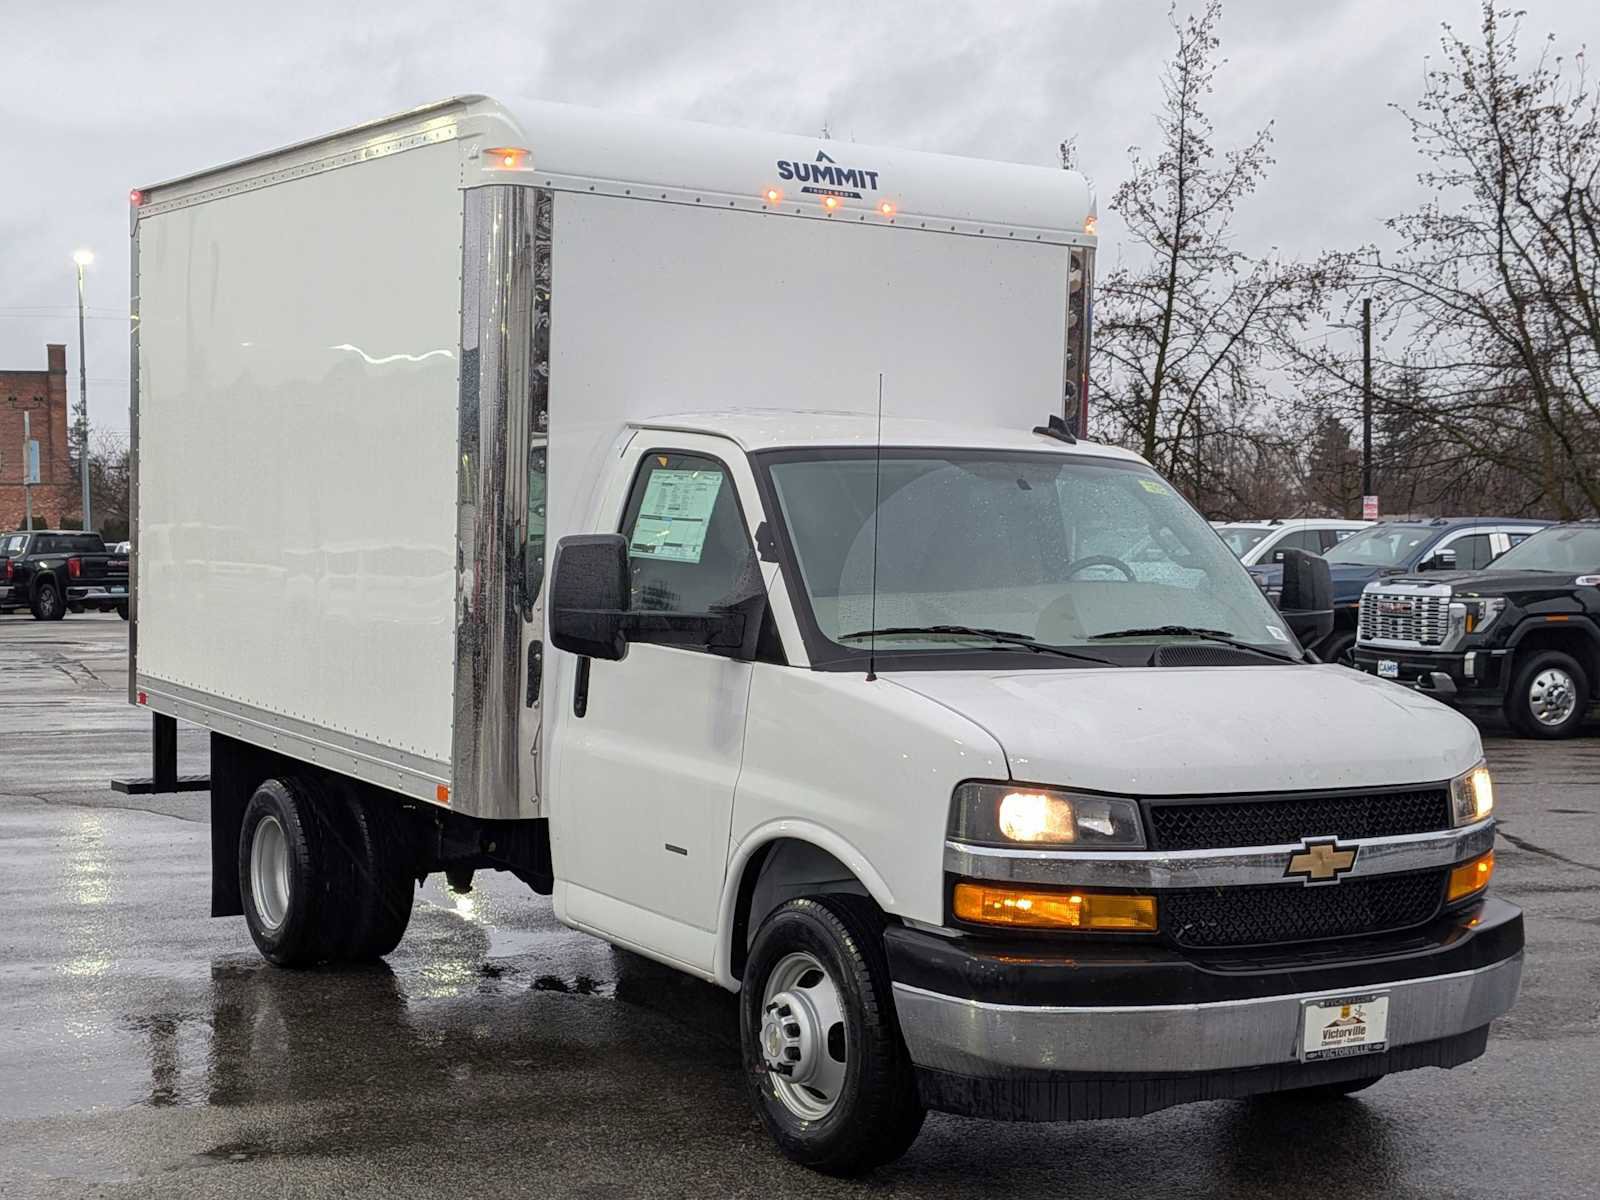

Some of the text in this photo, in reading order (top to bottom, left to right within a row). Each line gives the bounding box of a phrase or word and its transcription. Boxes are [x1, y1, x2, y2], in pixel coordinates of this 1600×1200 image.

[777, 161, 879, 190] SUMMIT
[1323, 1026, 1366, 1039] Victorville
[1322, 1044, 1369, 1057] VICTORVILLE
